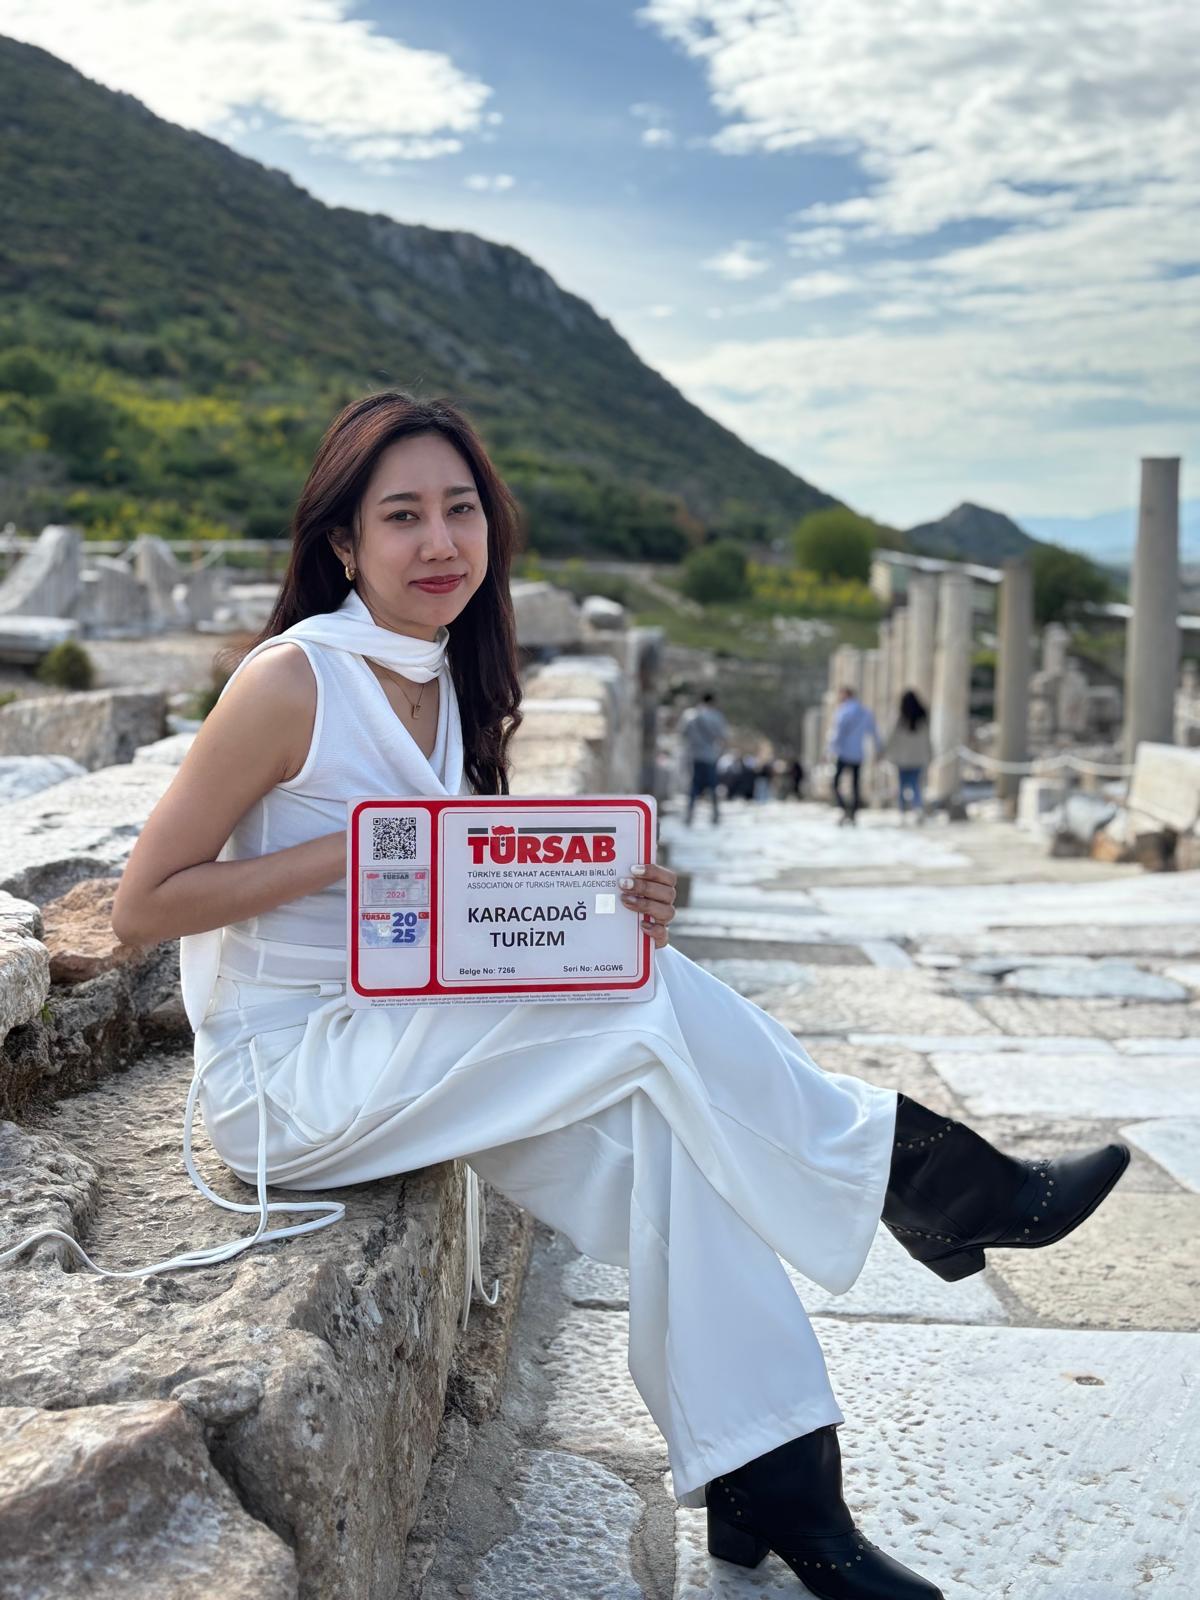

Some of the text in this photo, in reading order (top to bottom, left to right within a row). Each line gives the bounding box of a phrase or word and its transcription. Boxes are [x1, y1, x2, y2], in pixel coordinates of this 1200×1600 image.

[468, 835, 616, 864] TÜRSAB
[468, 870, 501, 878] TÜRKİYE
[589, 869, 617, 877] BİRLİĞİ
[525, 881, 555, 889] TURKISH
[582, 880, 617, 888] AGENCIES
[392, 912, 417, 927] 20
[468, 901, 587, 923] KARACADAĞ
[392, 928, 416, 943] 25
[490, 928, 565, 947] TURİZM
[594, 964, 623, 972] AGGW6
